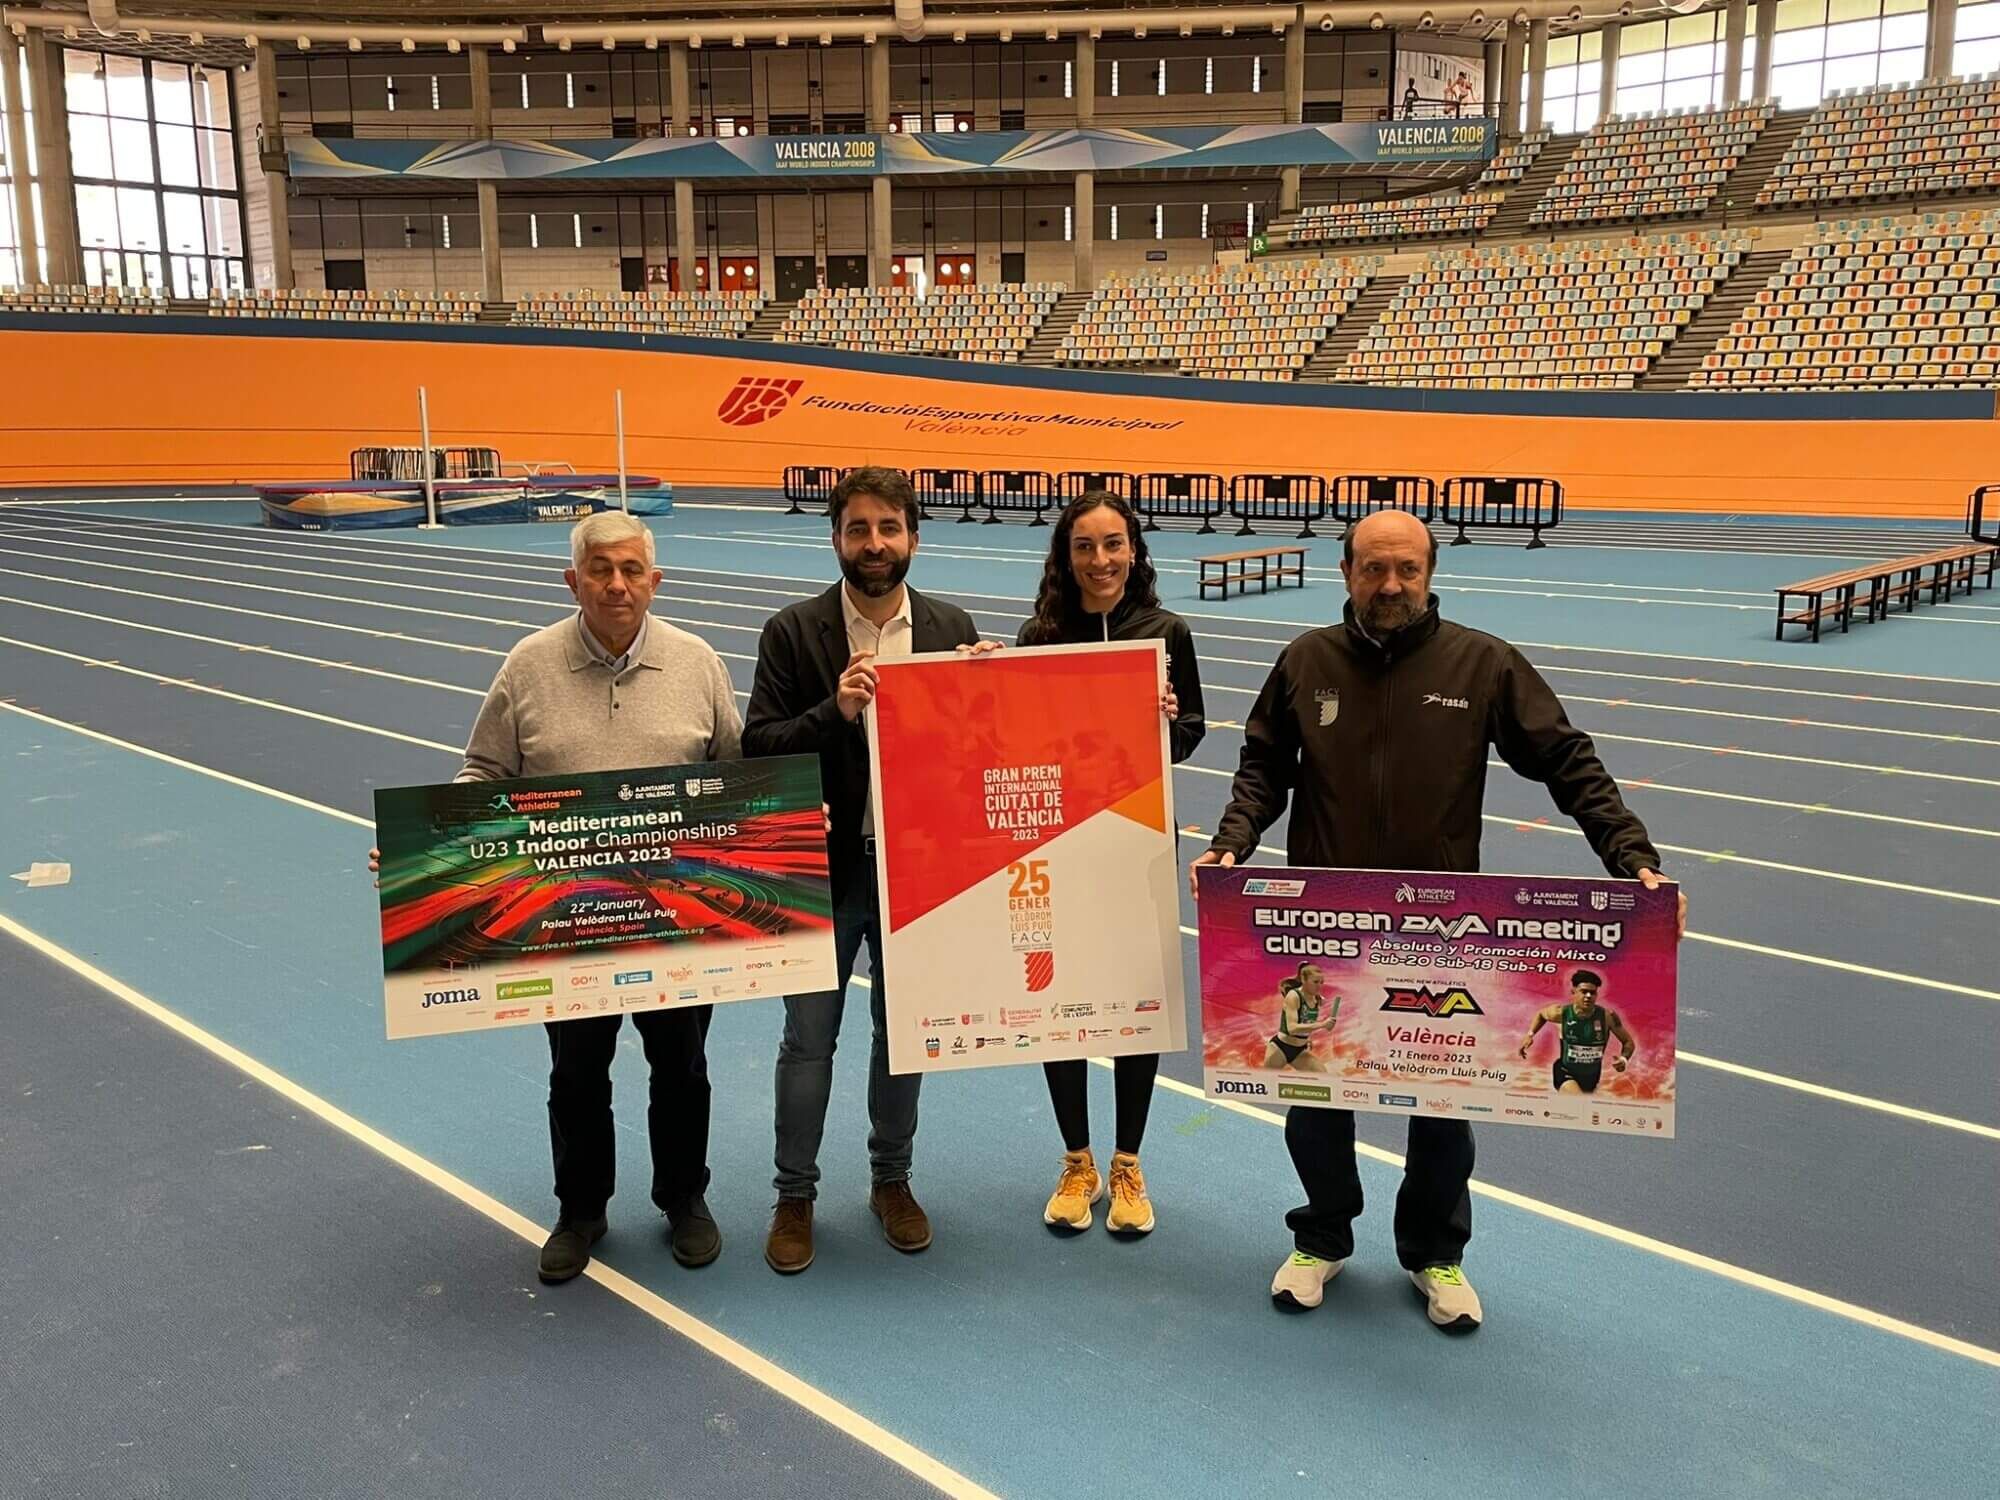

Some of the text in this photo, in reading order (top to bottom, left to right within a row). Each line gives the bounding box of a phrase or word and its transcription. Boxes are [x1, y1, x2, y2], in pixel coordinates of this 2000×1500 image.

[1378, 126, 1485, 145] VALENCIA 2008
[775, 141, 876, 159] VALENCIA 2008
[801, 395, 1185, 432] Fundació Esportiva Municipal
[538, 505, 574, 517] VALENCIA
[984, 764, 1062, 784] GRAN PREMI
[511, 788, 582, 802] Mediterranean
[984, 780, 1062, 795] INTERNACIONAL
[517, 801, 560, 812] Athletics
[985, 791, 1063, 812] CIUTAT DE
[529, 810, 683, 836] Mediterranean
[986, 807, 1064, 830] VALÈNCIA
[470, 822, 738, 860] U23 Indoor Championships
[1012, 828, 1040, 841] 2023
[534, 846, 672, 871] VALENCIA 2023
[1007, 860, 1051, 898] 25
[593, 898, 646, 912] January
[1008, 896, 1051, 911] GENER
[541, 917, 572, 930] Palau
[574, 912, 626, 927] Velòdrom
[654, 908, 677, 920] Puig
[619, 922, 646, 934] Spain
[1032, 920, 1052, 930] PUIG
[1011, 931, 1052, 944] FACV
[1497, 918, 1622, 948] meeting
[1370, 940, 1607, 962] Absoluto y Promoción Mixto
[1369, 953, 1557, 974] Sub-20 Sub-18 Sub-16
[1387, 1026, 1477, 1048] València
[1389, 1050, 1472, 1064] 21 Enero 2023
[1356, 1060, 1388, 1072] Palau
[1392, 1063, 1448, 1076] Velòdrom
[1480, 1069, 1507, 1082] Puig
